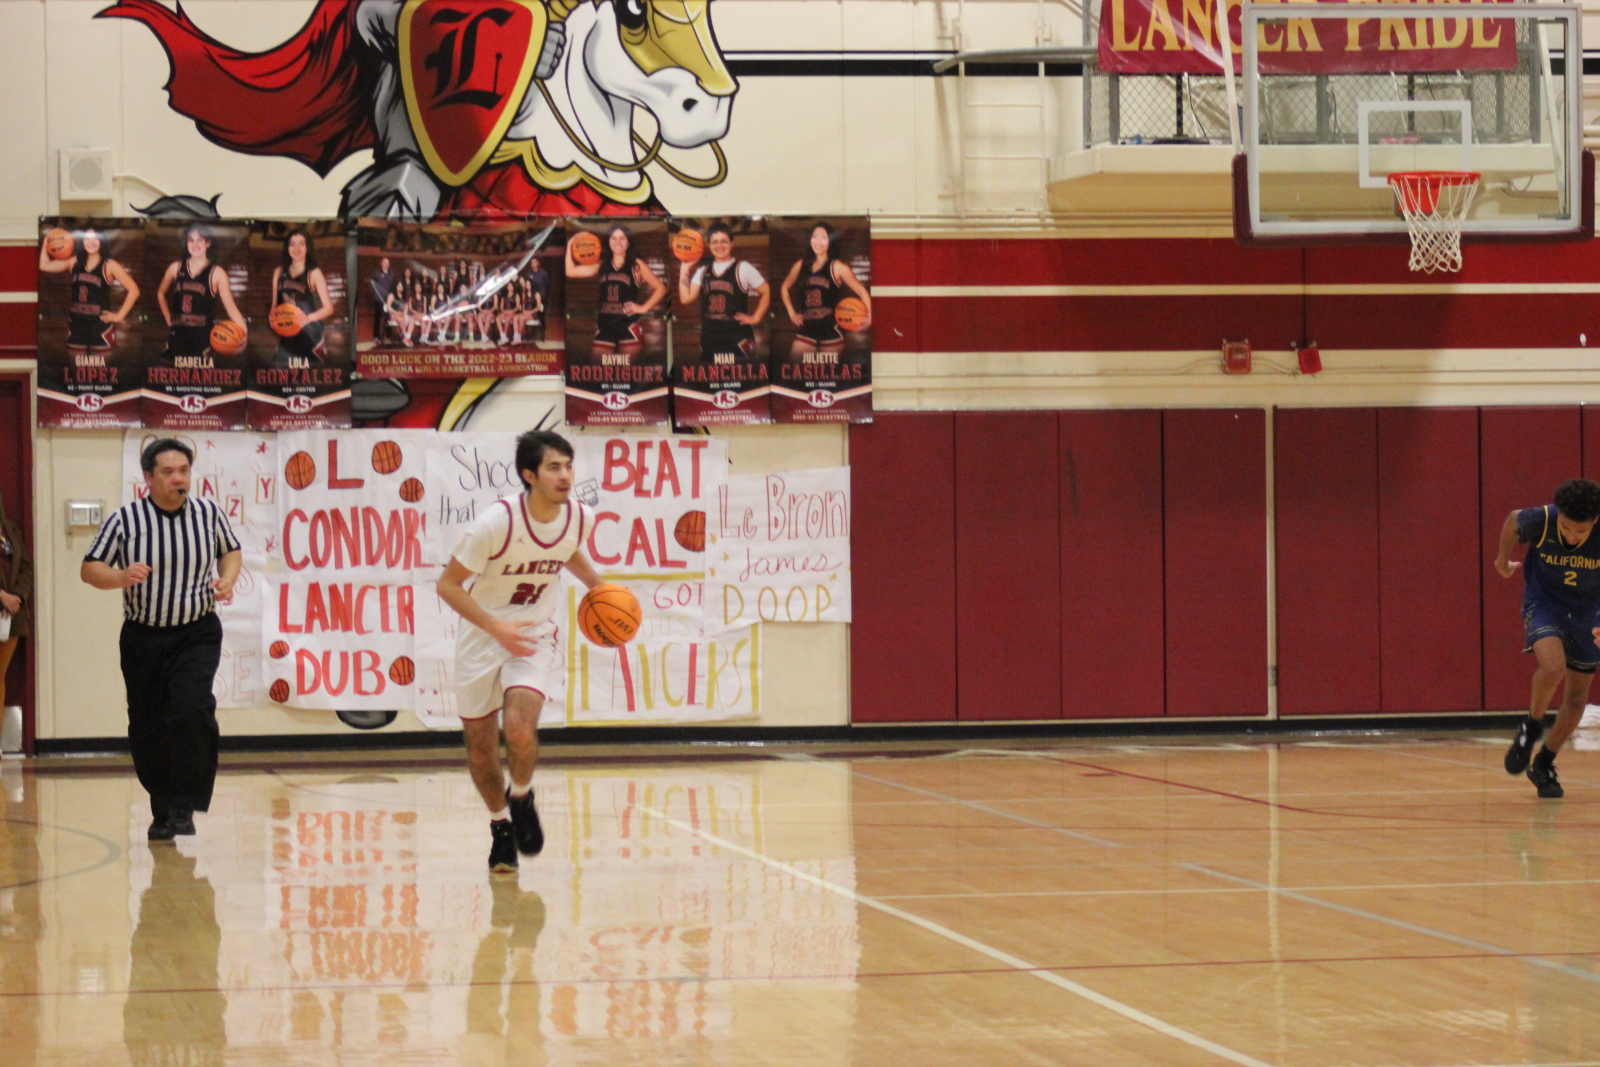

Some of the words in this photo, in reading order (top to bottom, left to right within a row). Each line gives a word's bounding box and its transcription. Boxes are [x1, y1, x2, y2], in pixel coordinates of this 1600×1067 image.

[75, 355, 106, 367] GIANNA
[174, 356, 215, 369] ISABELLA
[288, 357, 310, 369] LOLA
[360, 354, 389, 365] GOOD
[392, 354, 422, 365] LUCK
[425, 354, 440, 365] ON
[443, 353, 465, 364] THE
[515, 353, 557, 363] SEASON
[601, 354, 631, 366] RAYNIE
[714, 353, 735, 365] MIAH
[802, 352, 839, 364] JULIETTE
[63, 367, 118, 383] LOPEZ
[147, 367, 241, 385] HERNANDEZ
[256, 369, 342, 385] GONZALEZ
[570, 365, 663, 382] RODRIGUEZ
[682, 364, 769, 382] MANCILLA
[781, 364, 862, 380] CASILLAS
[80, 395, 101, 411] LS
[184, 396, 205, 412] LS
[290, 397, 310, 412] LS
[606, 393, 628, 409] LS
[717, 392, 737, 408] LS
[811, 391, 832, 407] LS
[328, 439, 364, 490] L
[450, 444, 524, 491] Shoo
[601, 438, 709, 500] BEAT
[437, 494, 476, 525] that
[283, 506, 435, 571] CONDOR
[586, 511, 687, 568] CAL
[1564, 571, 1578, 587] 2
[654, 583, 705, 609] GOT
[278, 581, 415, 636] LANCER
[295, 647, 386, 697] DUB
